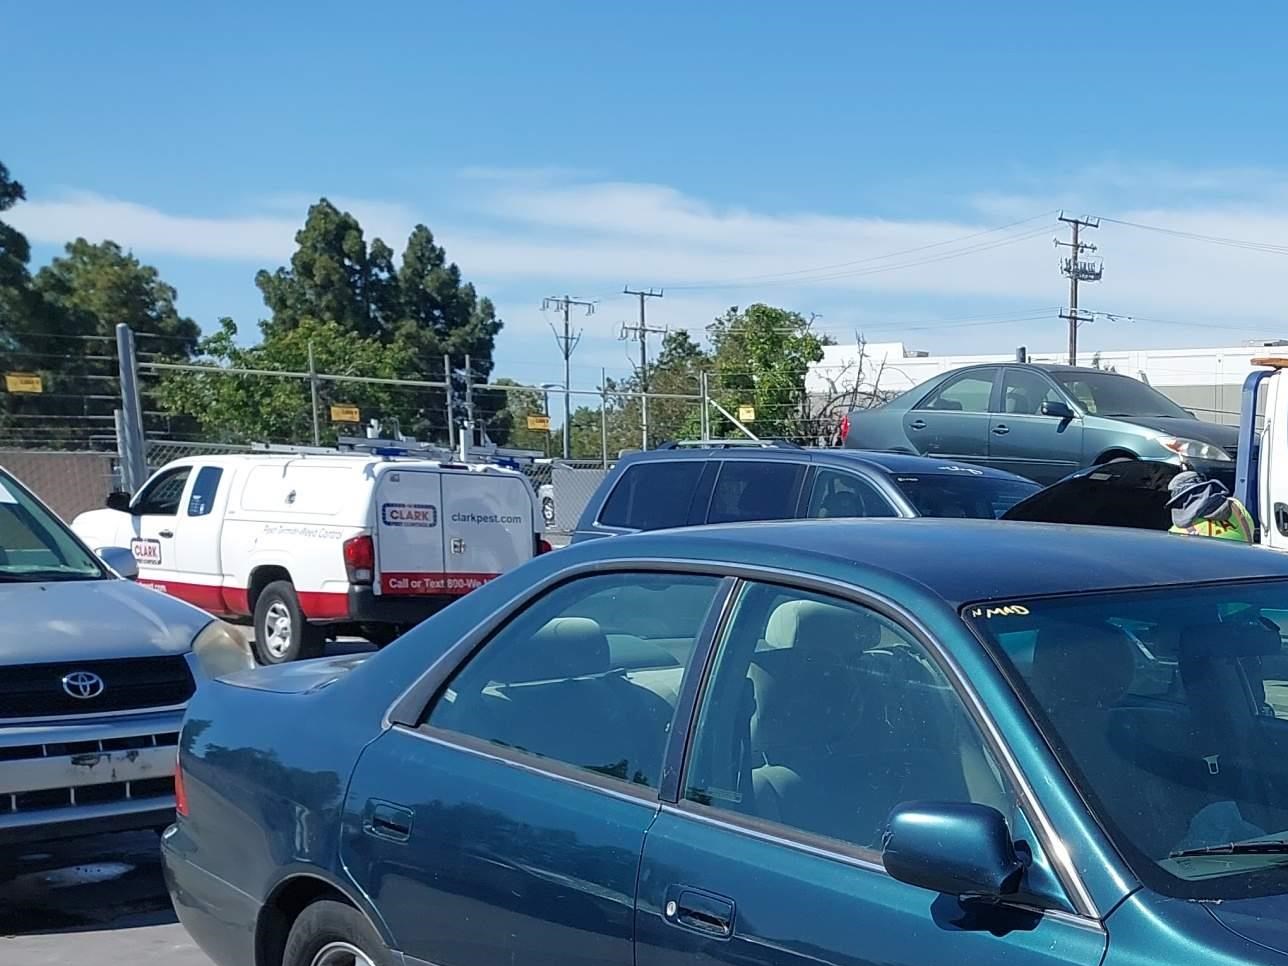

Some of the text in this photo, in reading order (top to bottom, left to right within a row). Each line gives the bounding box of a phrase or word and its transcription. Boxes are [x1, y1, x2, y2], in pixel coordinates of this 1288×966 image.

[390, 510, 429, 521] CLARK
[451, 512, 522, 524] clarkpest.com
[134, 545, 158, 557] CLARK
[389, 578, 409, 589] Call
[410, 580, 421, 589] or
[423, 578, 445, 589] Text
